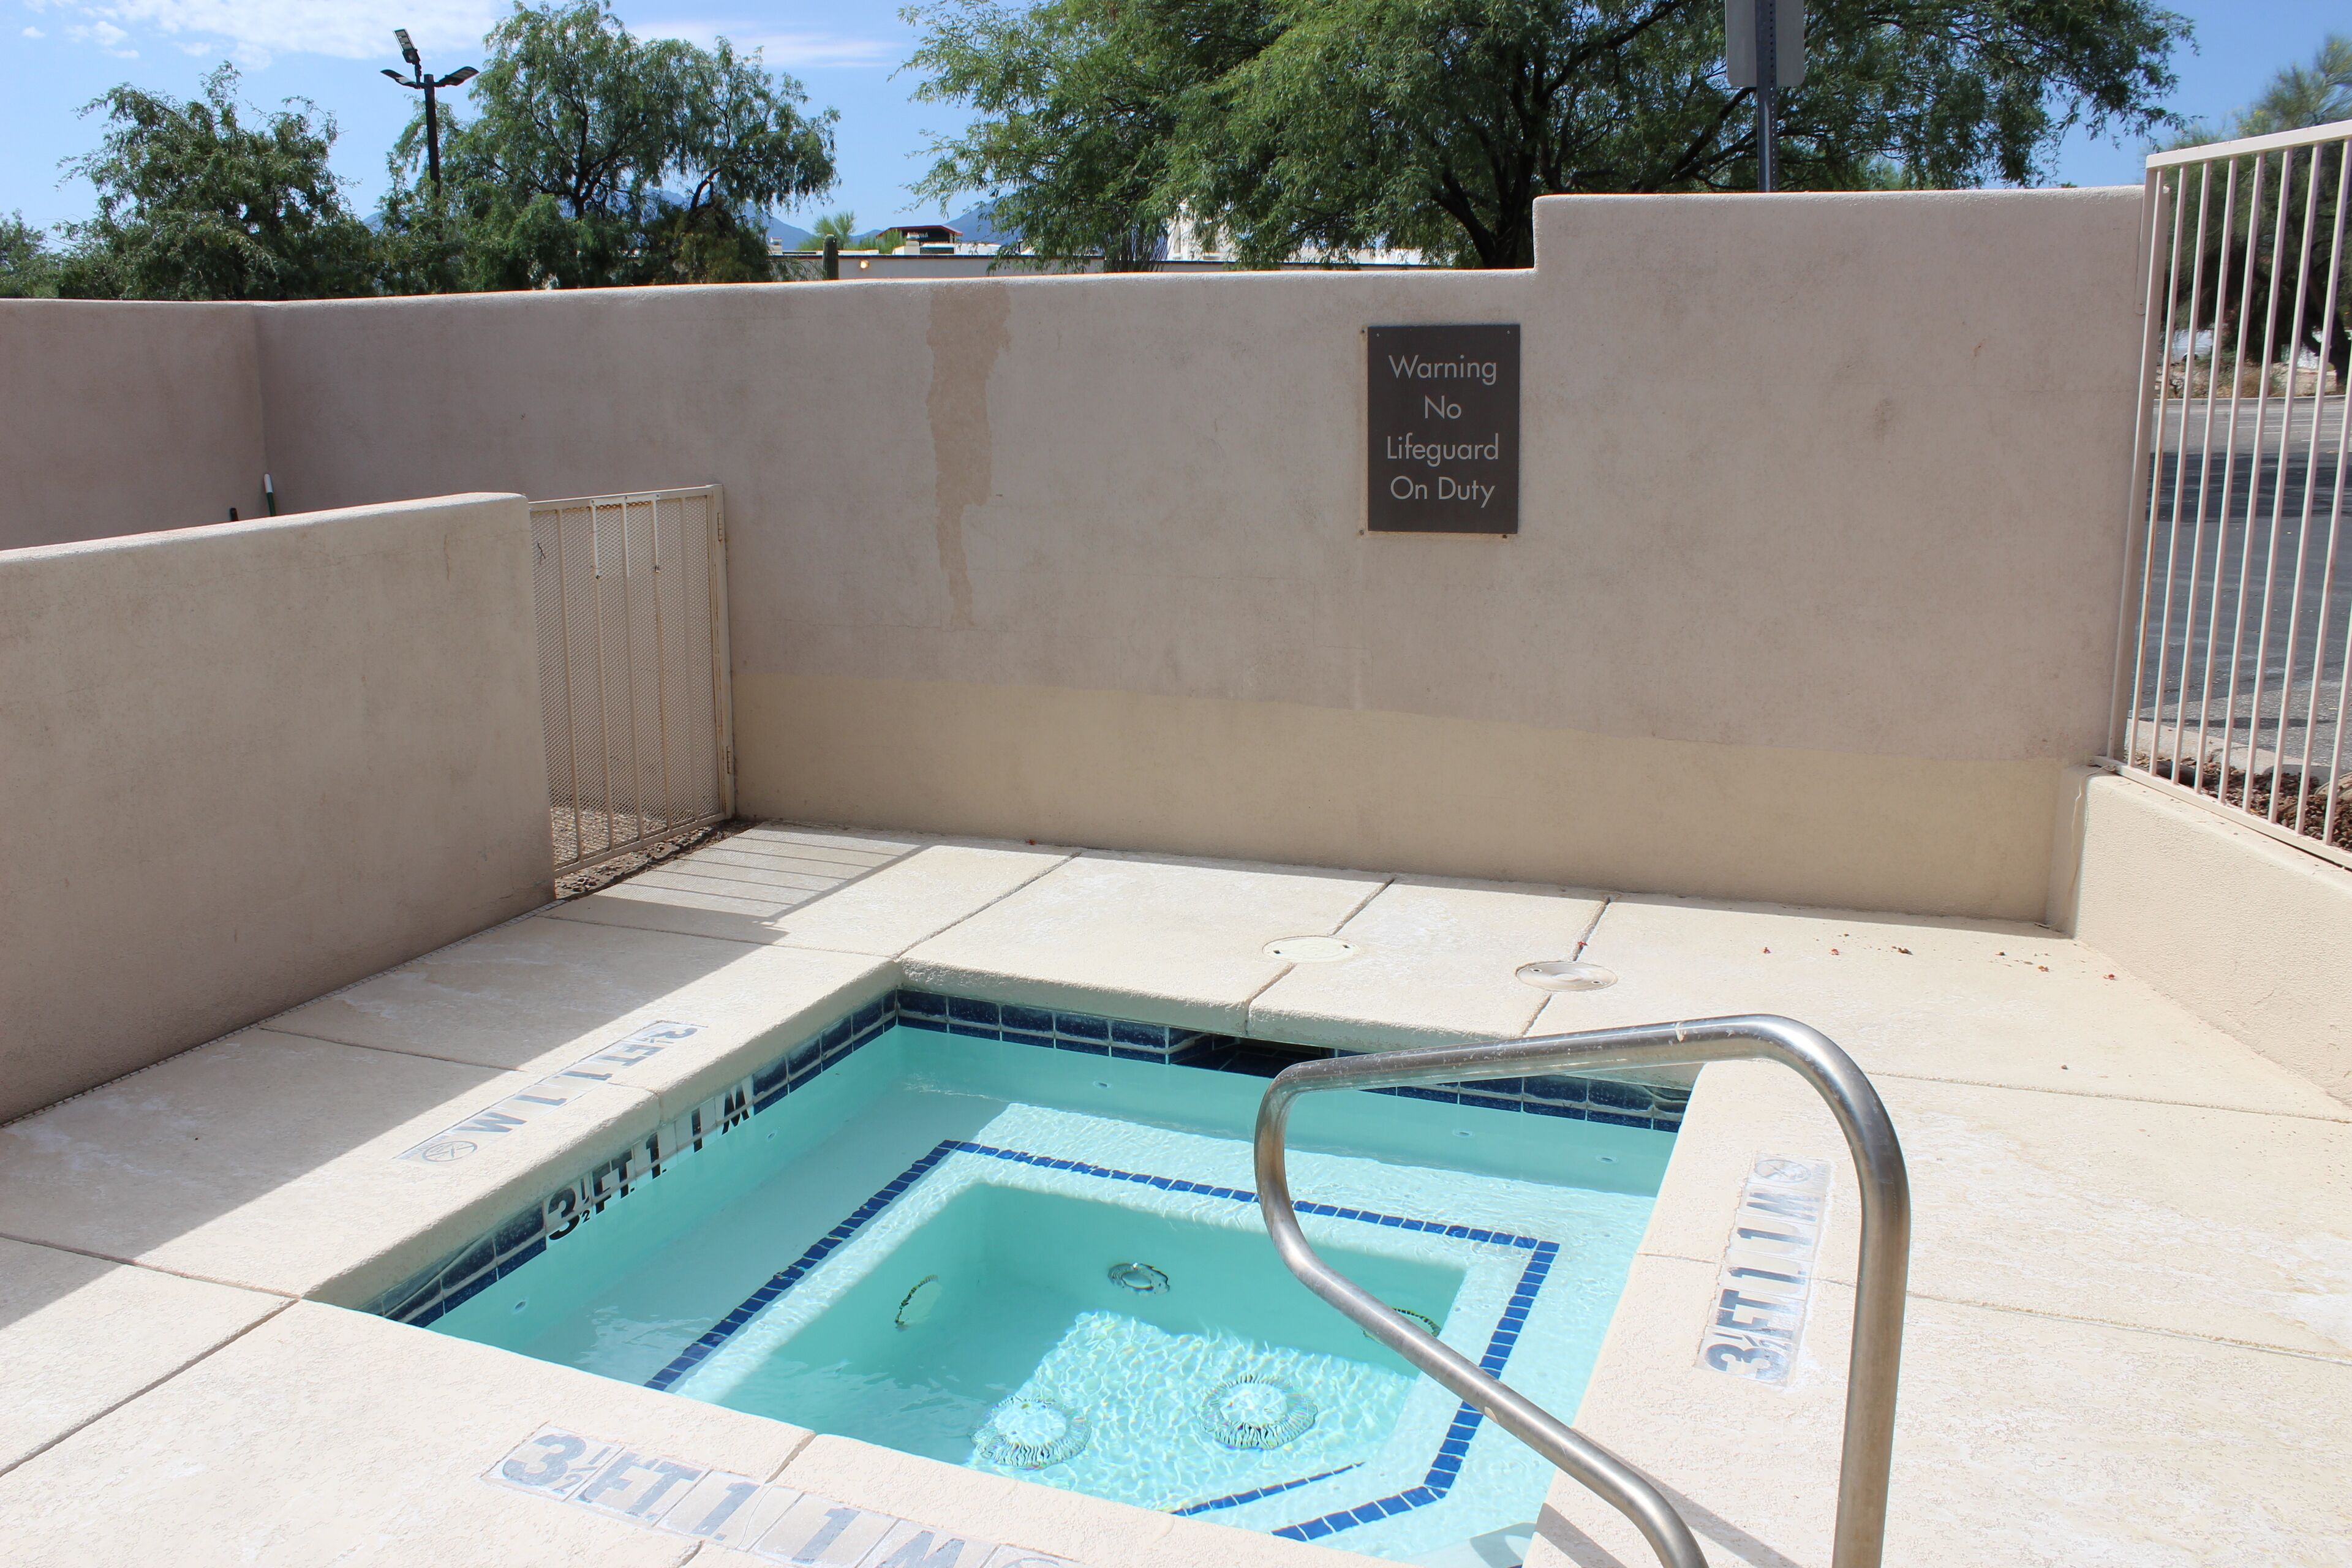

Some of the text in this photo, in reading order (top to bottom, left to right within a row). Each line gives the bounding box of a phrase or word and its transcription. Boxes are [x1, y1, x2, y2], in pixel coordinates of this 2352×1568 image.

[1388, 354, 1497, 385] Warning
[1424, 394, 1462, 419] No
[1387, 432, 1499, 467] Lifeguard
[1390, 475, 1495, 508] On Duty
[454, 1112, 528, 1133] M
[722, 1084, 750, 1136] M
[1746, 1192, 1821, 1223] M
